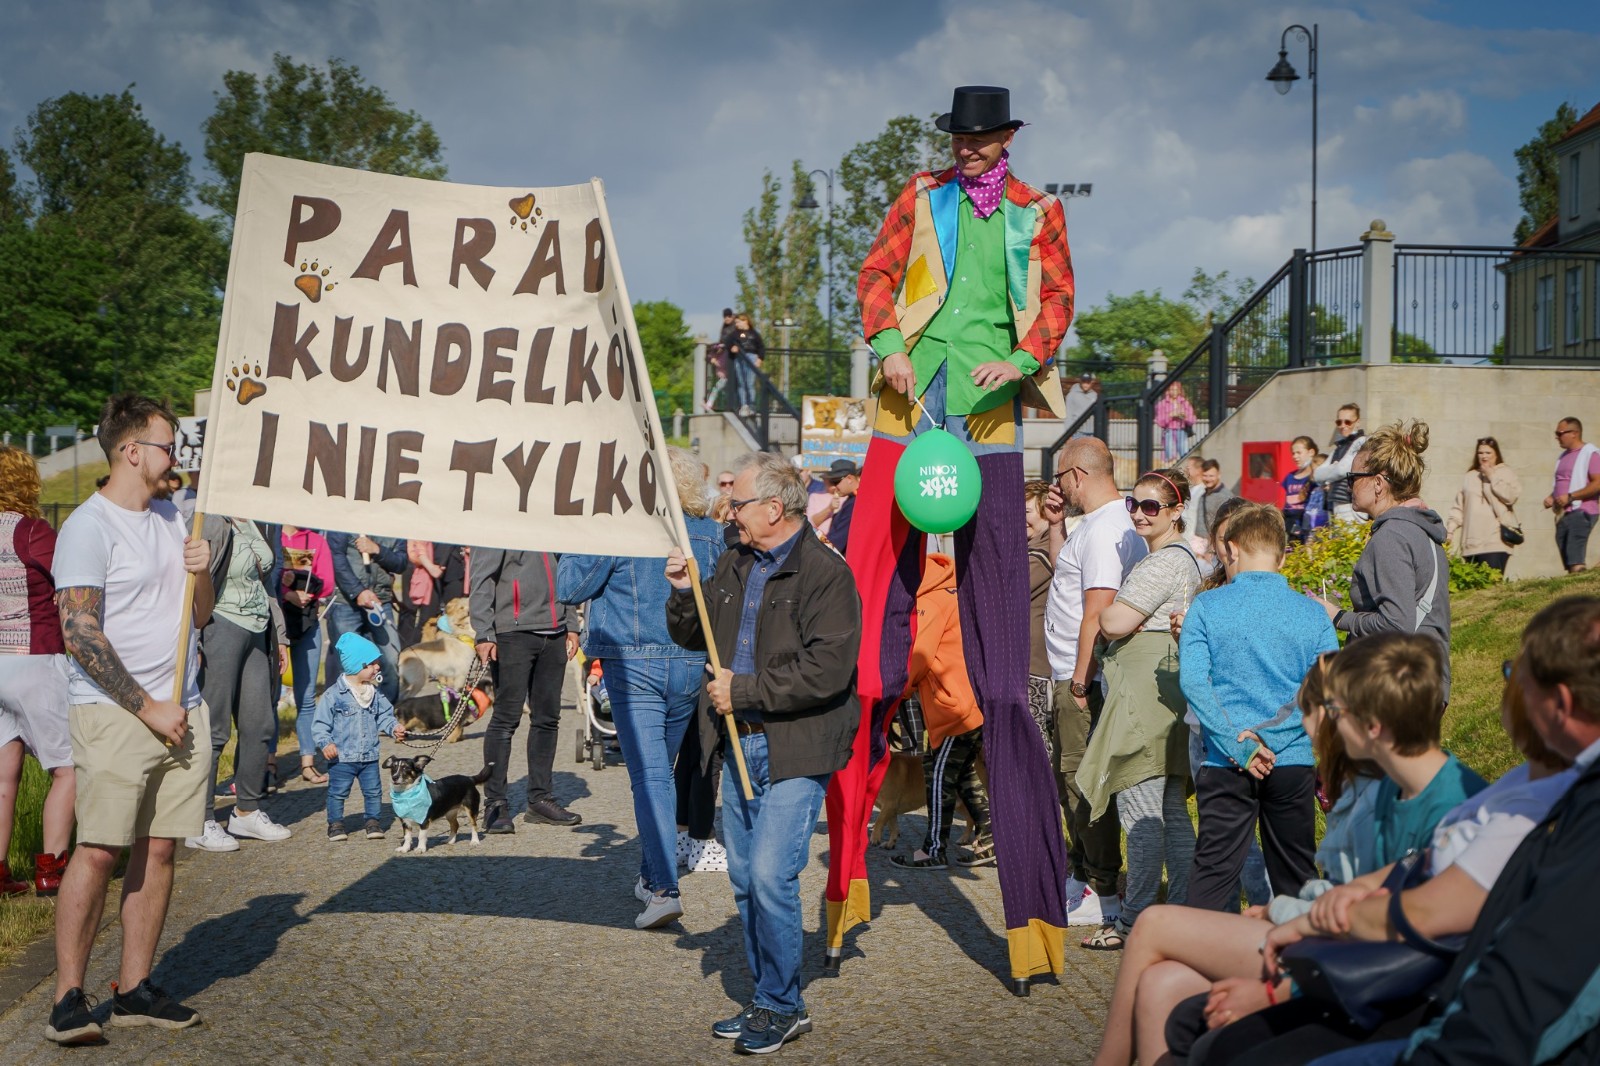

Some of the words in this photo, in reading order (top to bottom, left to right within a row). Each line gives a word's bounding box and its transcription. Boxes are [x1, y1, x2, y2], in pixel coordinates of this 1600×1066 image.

[284, 194, 606, 296] PARAD
[252, 411, 280, 488] I
[303, 420, 425, 505] NIE
[920, 465, 957, 476] KONIN
